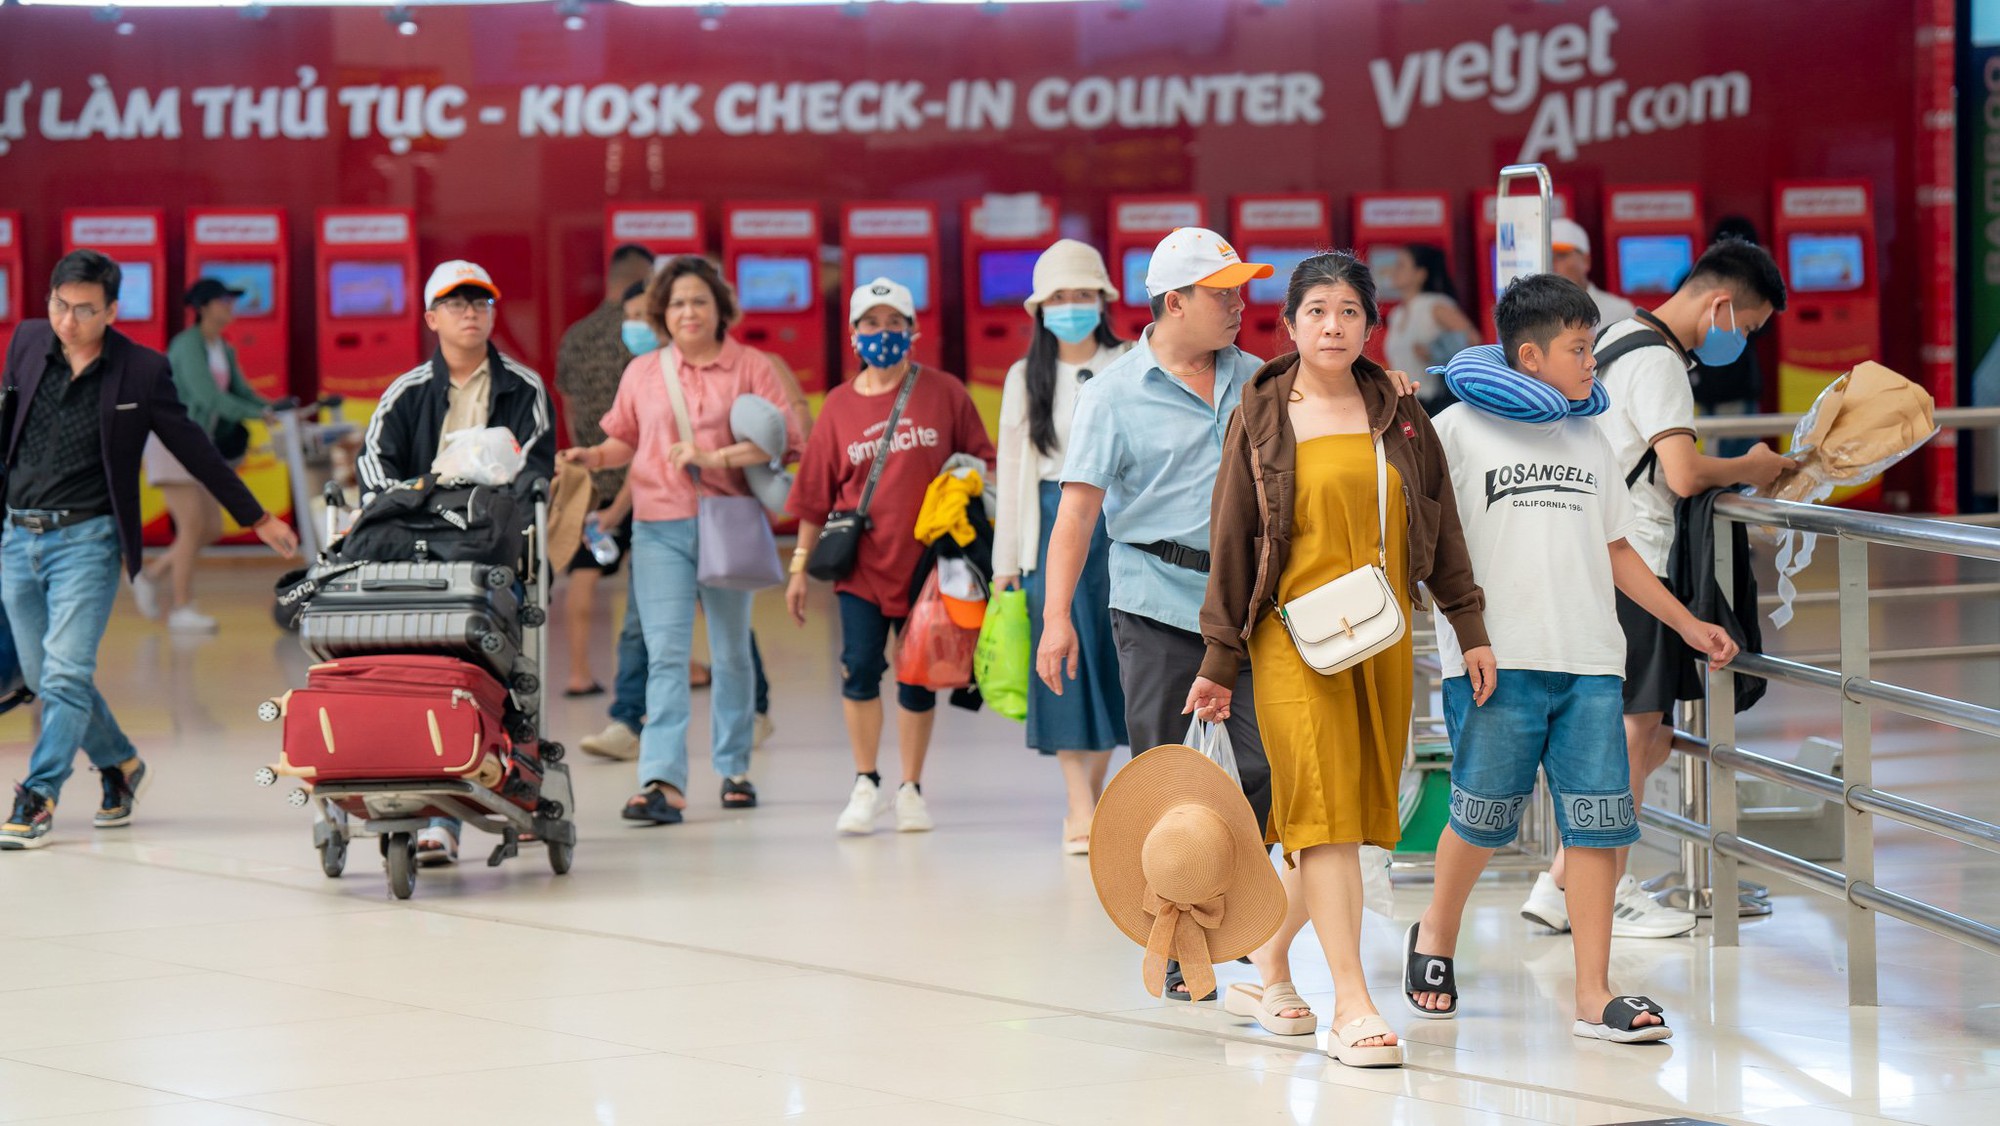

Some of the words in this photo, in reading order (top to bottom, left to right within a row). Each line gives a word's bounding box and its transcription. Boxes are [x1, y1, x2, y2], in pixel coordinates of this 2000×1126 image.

[1369, 8, 1619, 128] Vietjet
[40, 74, 182, 140] LÀM
[192, 65, 329, 140] THỦ
[338, 84, 469, 155] TỤC
[518, 82, 704, 137] KIOSK
[714, 78, 1015, 136] CHECK-IN
[1027, 72, 1325, 130] COUNTER
[1512, 499, 1567, 510] CALIFORNIA
[1452, 789, 1523, 830] SURF
[1425, 958, 1446, 986] C
